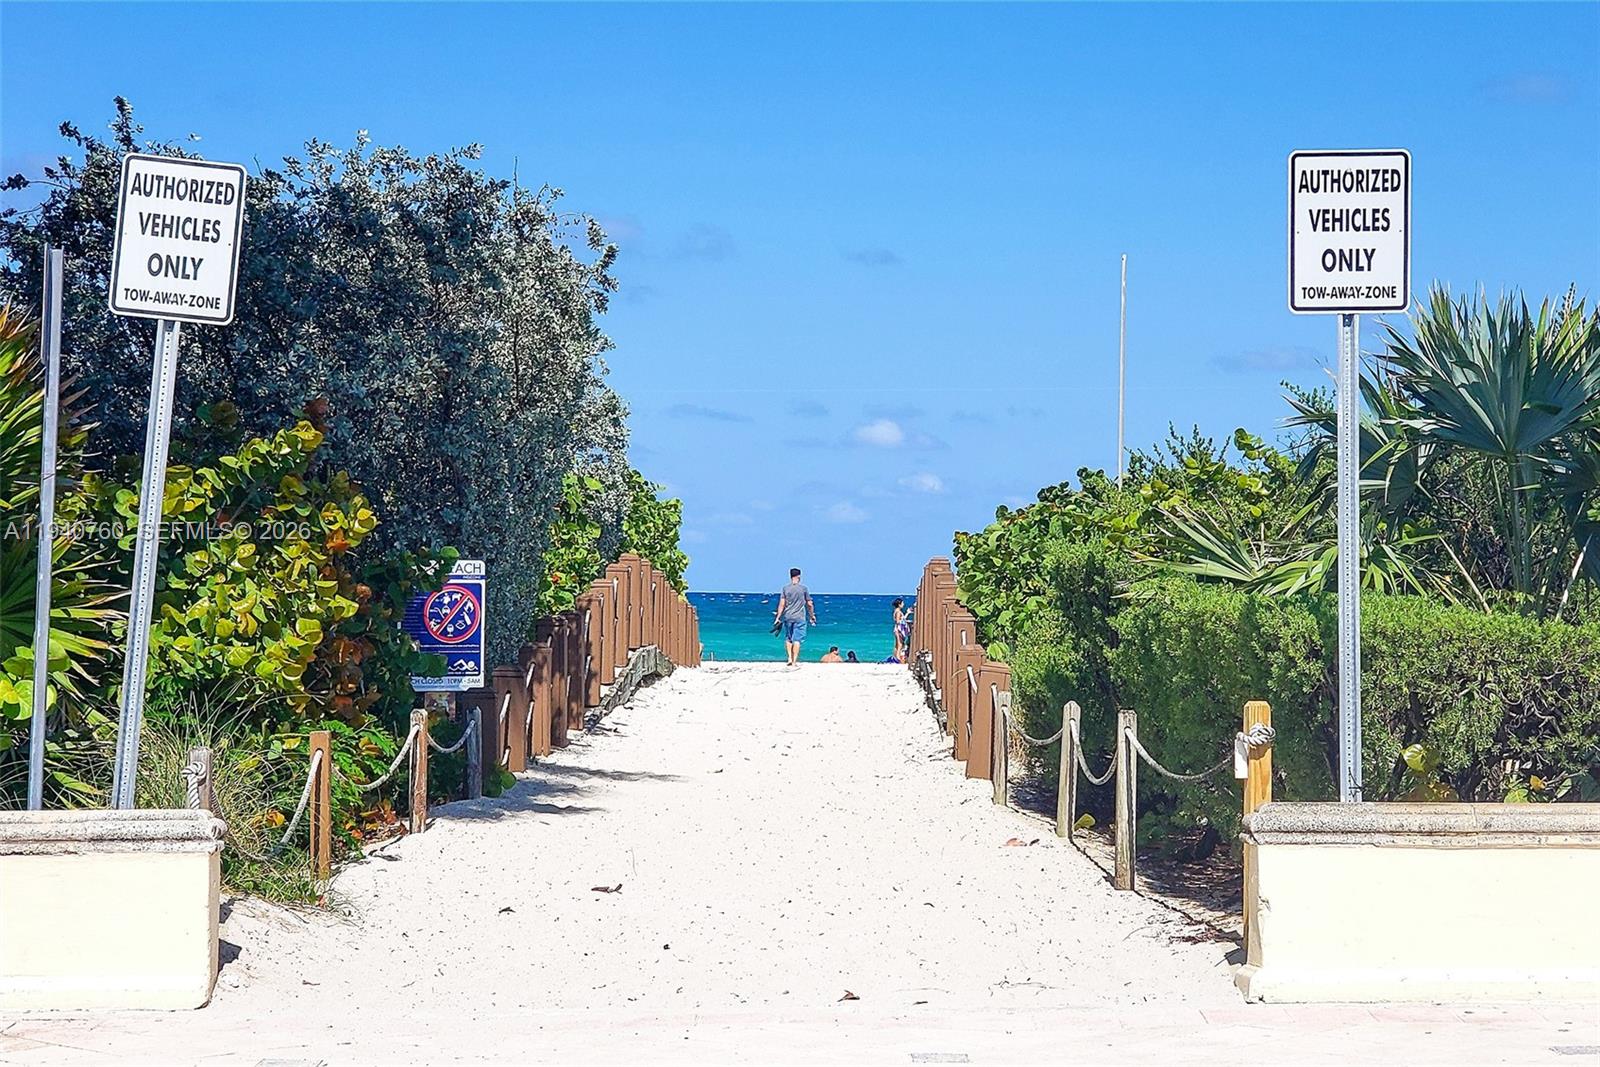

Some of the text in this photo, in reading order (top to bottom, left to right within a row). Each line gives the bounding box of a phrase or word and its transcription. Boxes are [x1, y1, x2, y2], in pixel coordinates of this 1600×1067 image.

[130, 173, 235, 206] AUTHORIZED
[1298, 169, 1401, 194] AUTHORIZED
[139, 212, 221, 243] VEHICLES
[1308, 208, 1391, 232] VEHICLES
[147, 253, 203, 281] ONLY
[1321, 248, 1376, 273] ONLY
[124, 288, 221, 310] TOW-AWAY-ZONE
[1302, 286, 1397, 299] TOW-AWAY-ZONE
[453, 562, 482, 574] ACH
